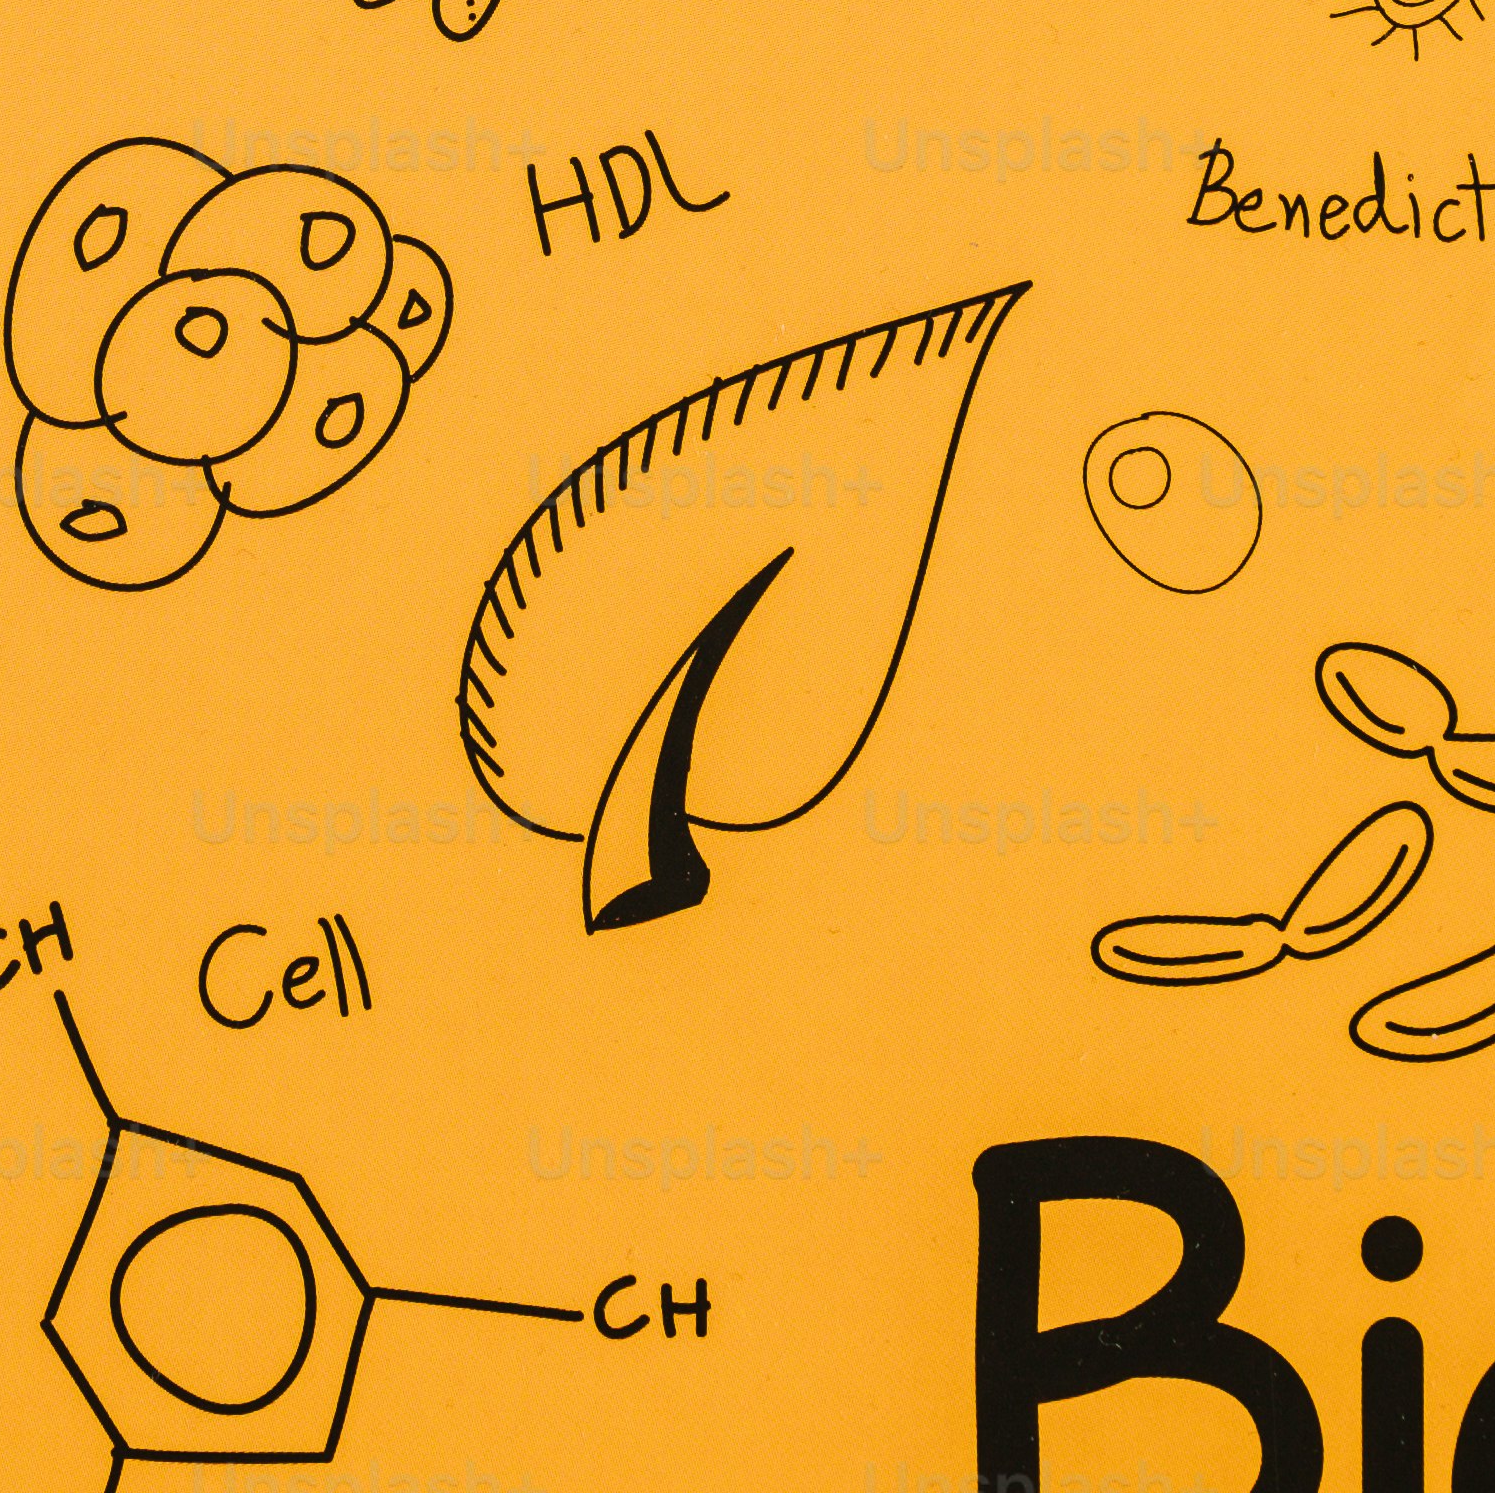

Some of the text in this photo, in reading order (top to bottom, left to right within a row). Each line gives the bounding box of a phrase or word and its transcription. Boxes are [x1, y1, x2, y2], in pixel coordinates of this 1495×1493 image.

[527, 129, 731, 257] HDL
[198, 913, 372, 1030] Cell
[593, 1274, 712, 1340] CH
